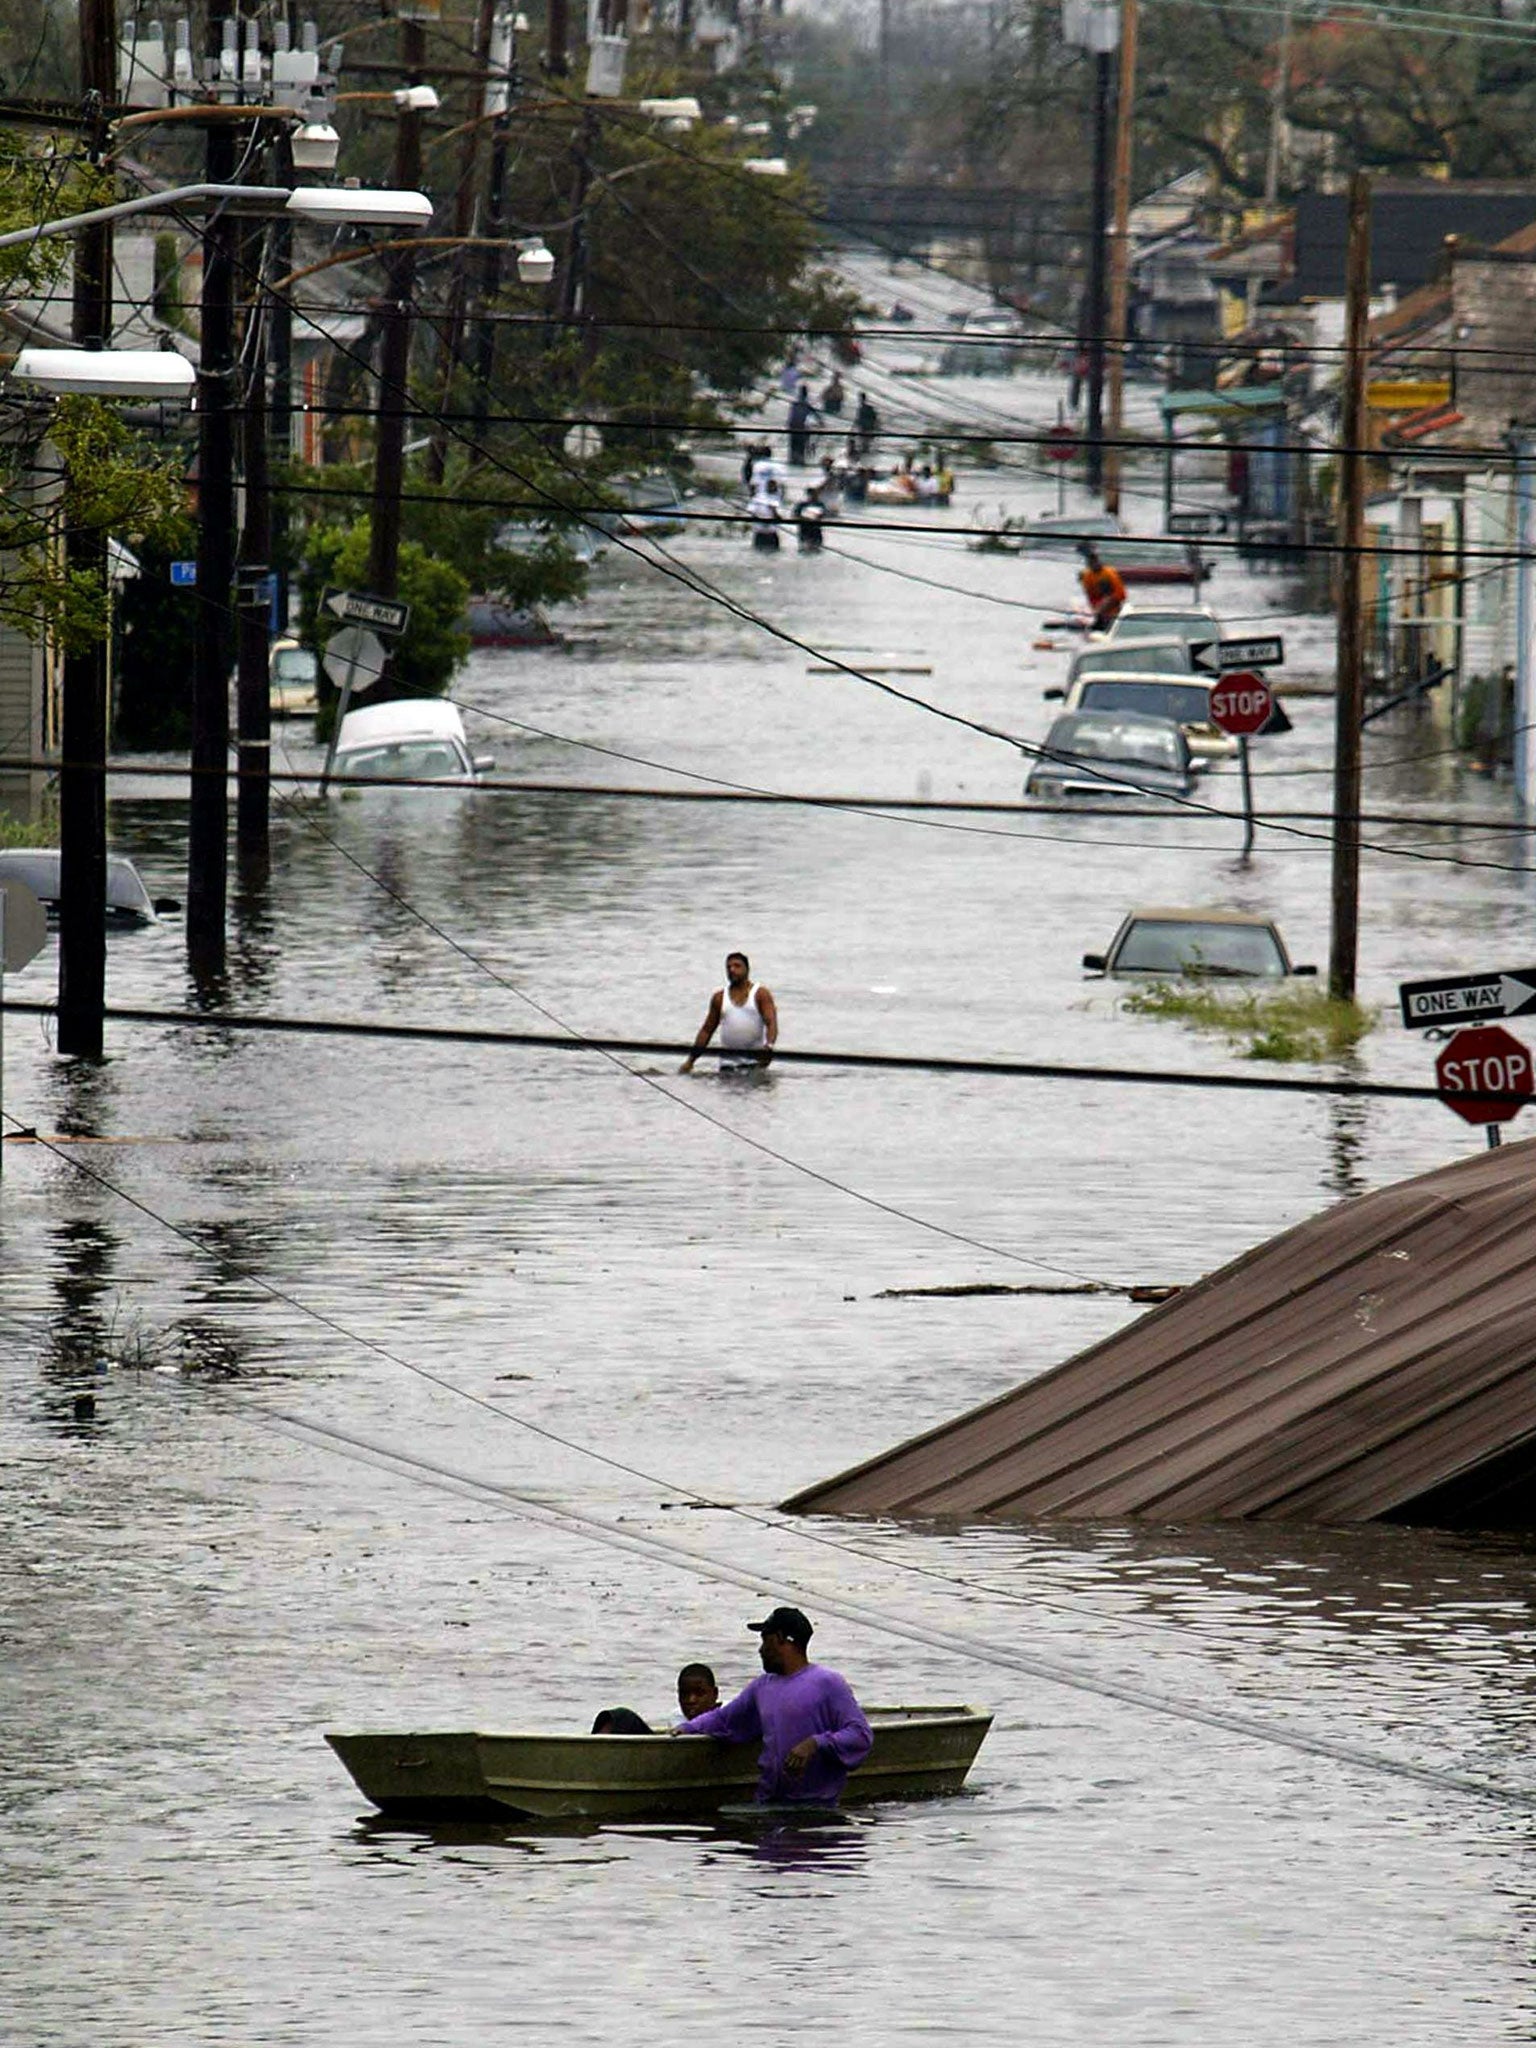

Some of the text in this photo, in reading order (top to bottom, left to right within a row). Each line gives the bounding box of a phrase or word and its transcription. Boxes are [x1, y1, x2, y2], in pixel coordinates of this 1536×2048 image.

[346, 601, 397, 621] ONE WAY
[1247, 645, 1273, 658] WAY
[1212, 691, 1266, 717] STOP
[1416, 987, 1502, 1013] ONE WAY
[1442, 1054, 1526, 1091] STOP
